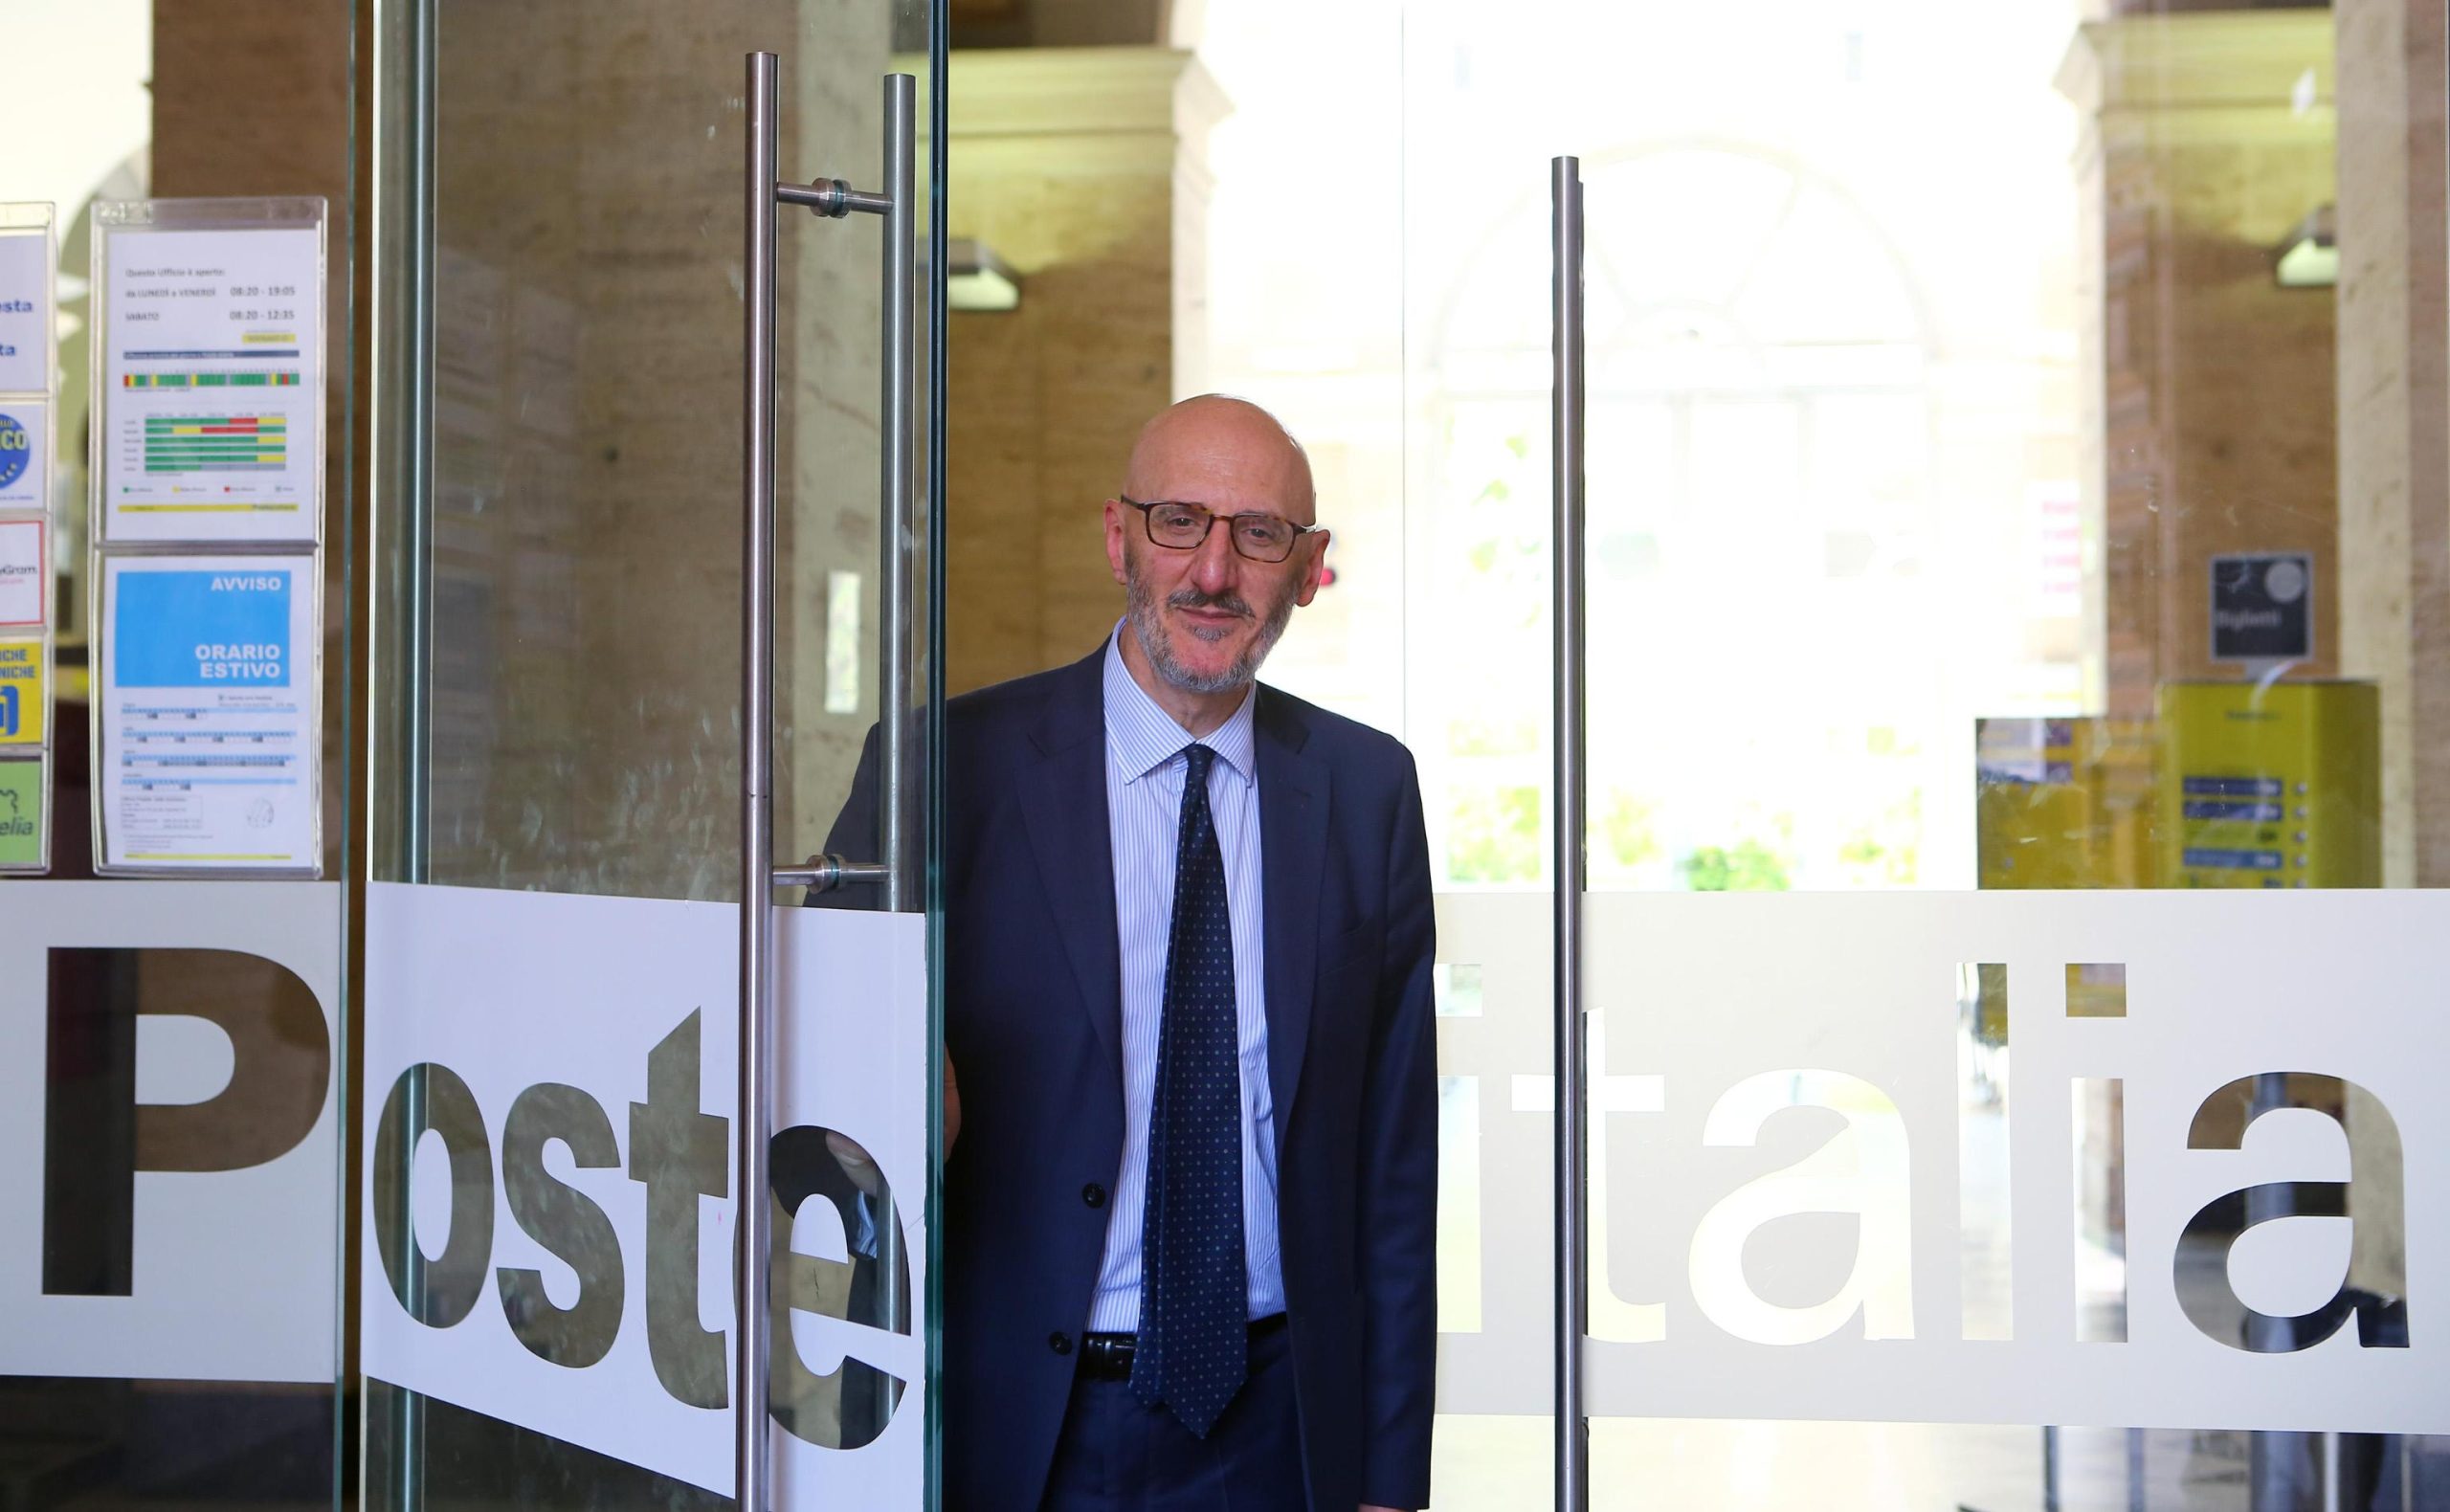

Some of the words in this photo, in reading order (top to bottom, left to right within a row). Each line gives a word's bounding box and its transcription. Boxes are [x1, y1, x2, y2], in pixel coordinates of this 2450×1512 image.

[230, 286, 258, 297] 08:20
[269, 286, 295, 297] 19:05
[0, 300, 33, 313] sta
[230, 310, 258, 321] 08:20
[0, 430, 28, 450] CO
[211, 576, 281, 591] AVVISO
[194, 644, 281, 660] ORARIO
[200, 662, 280, 679] ESTIVO
[42, 946, 912, 1451] Poste
